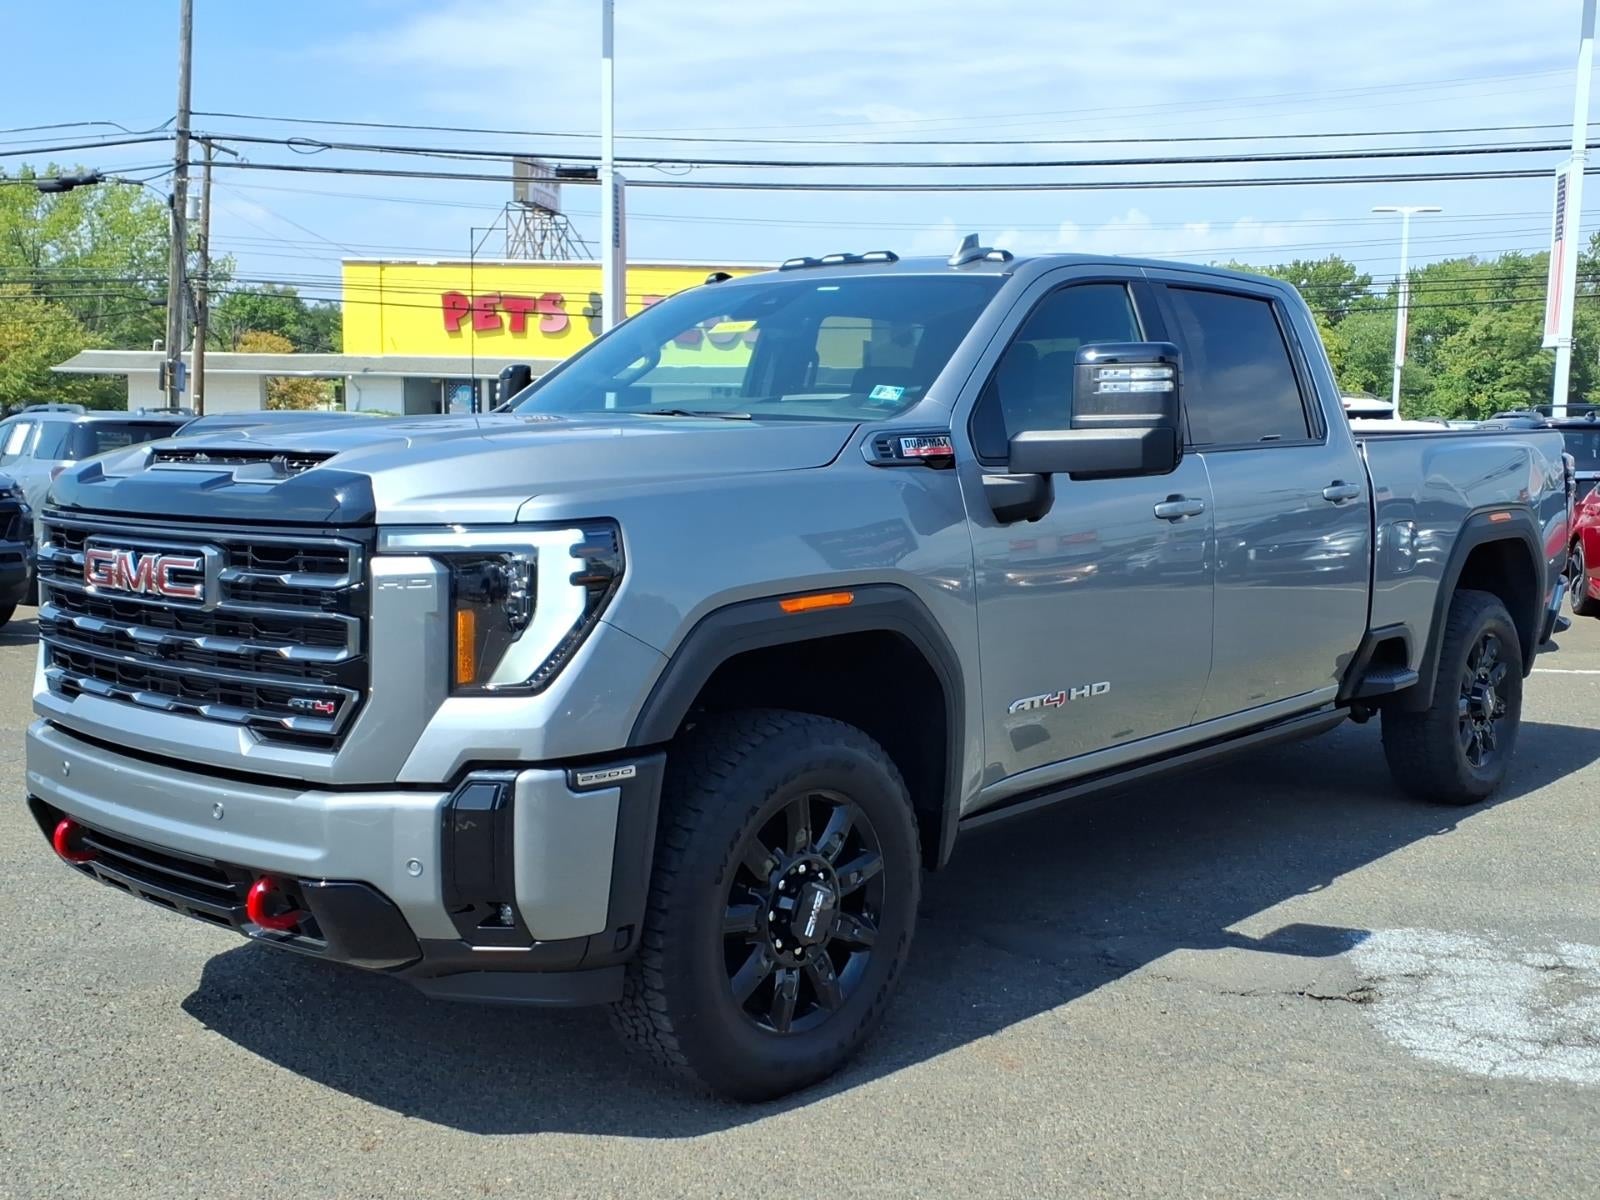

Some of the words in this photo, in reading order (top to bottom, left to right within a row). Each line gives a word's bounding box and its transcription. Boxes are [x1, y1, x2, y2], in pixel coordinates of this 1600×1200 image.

[441, 290, 569, 333] PETS
[904, 437, 949, 449] DURAMAX
[84, 549, 203, 600] GMC
[287, 697, 335, 714] AT4
[1008, 690, 1066, 714] AT4
[1069, 681, 1111, 701] HD
[581, 768, 633, 782] 2500
